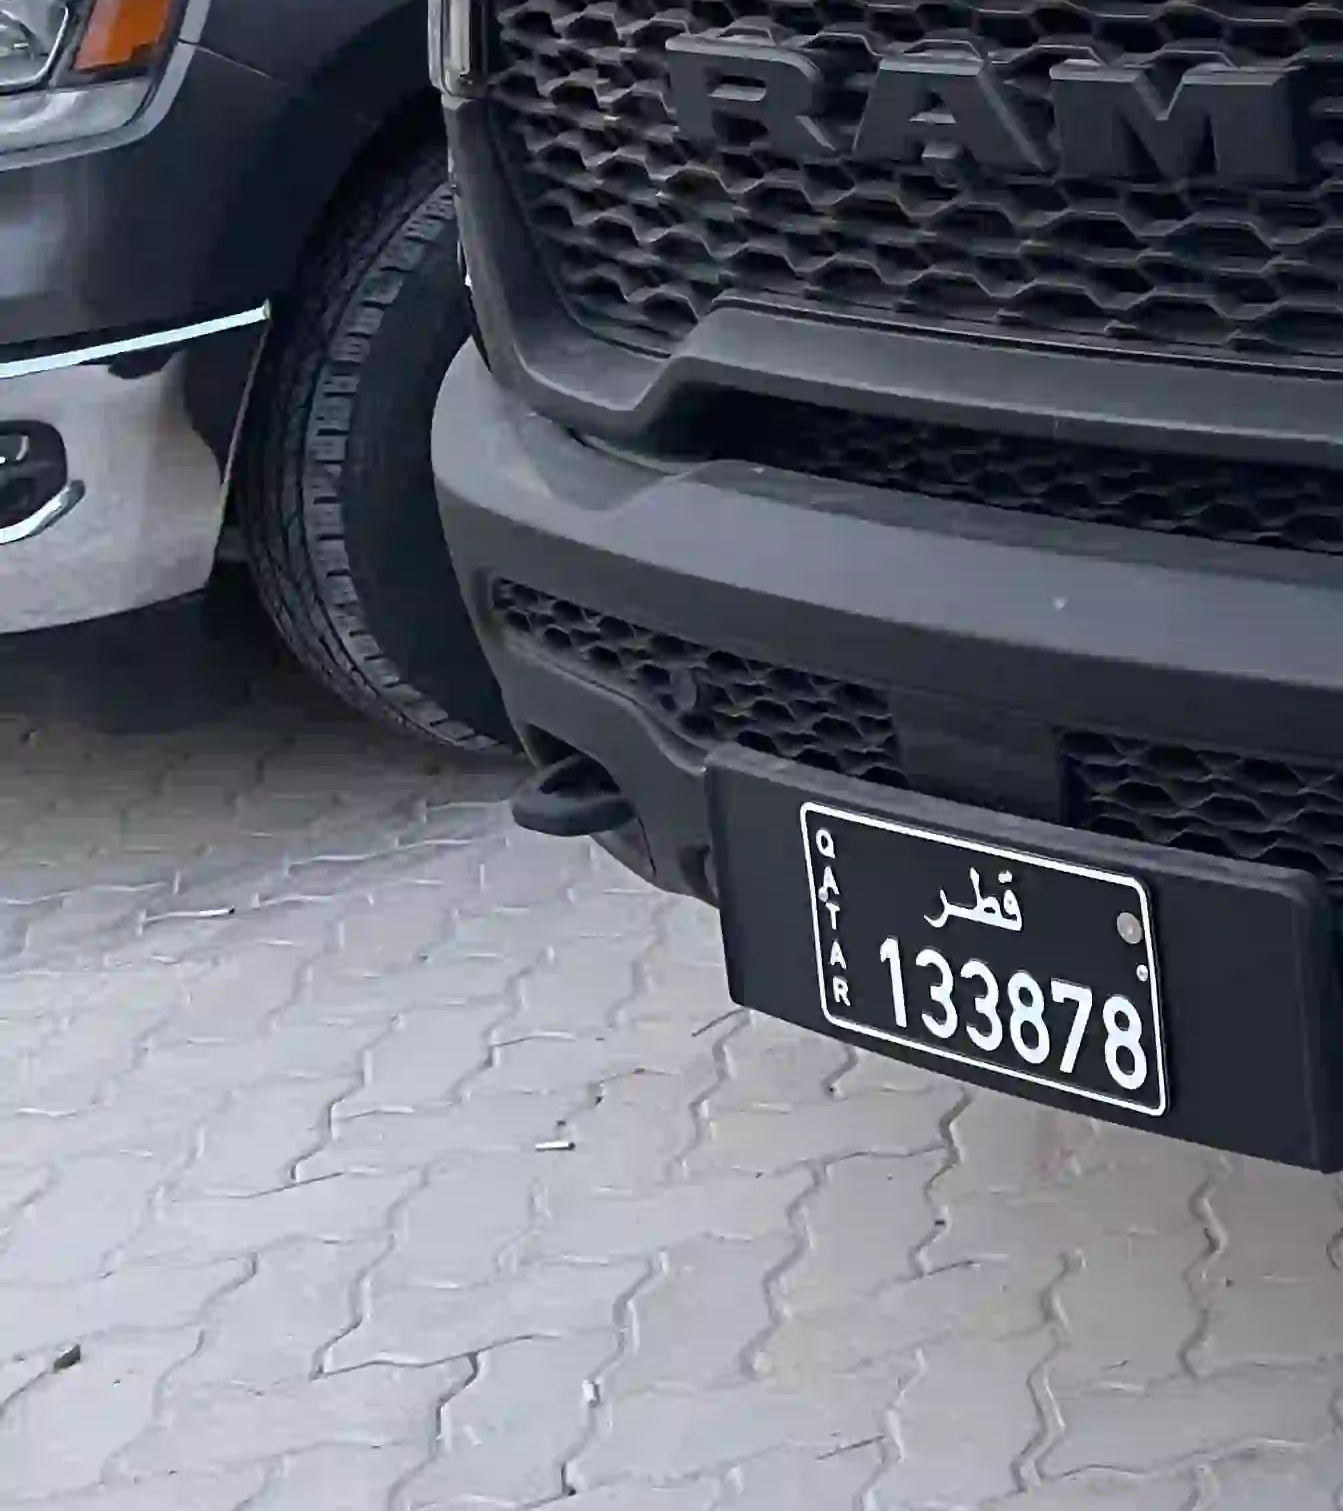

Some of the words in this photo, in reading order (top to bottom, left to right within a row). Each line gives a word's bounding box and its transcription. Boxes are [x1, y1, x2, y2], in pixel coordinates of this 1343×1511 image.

[664, 32, 1302, 184] RAM
[815, 828, 851, 1007] QATAR
[923, 866, 1023, 932] قطر
[879, 936, 1148, 1090] 133878
